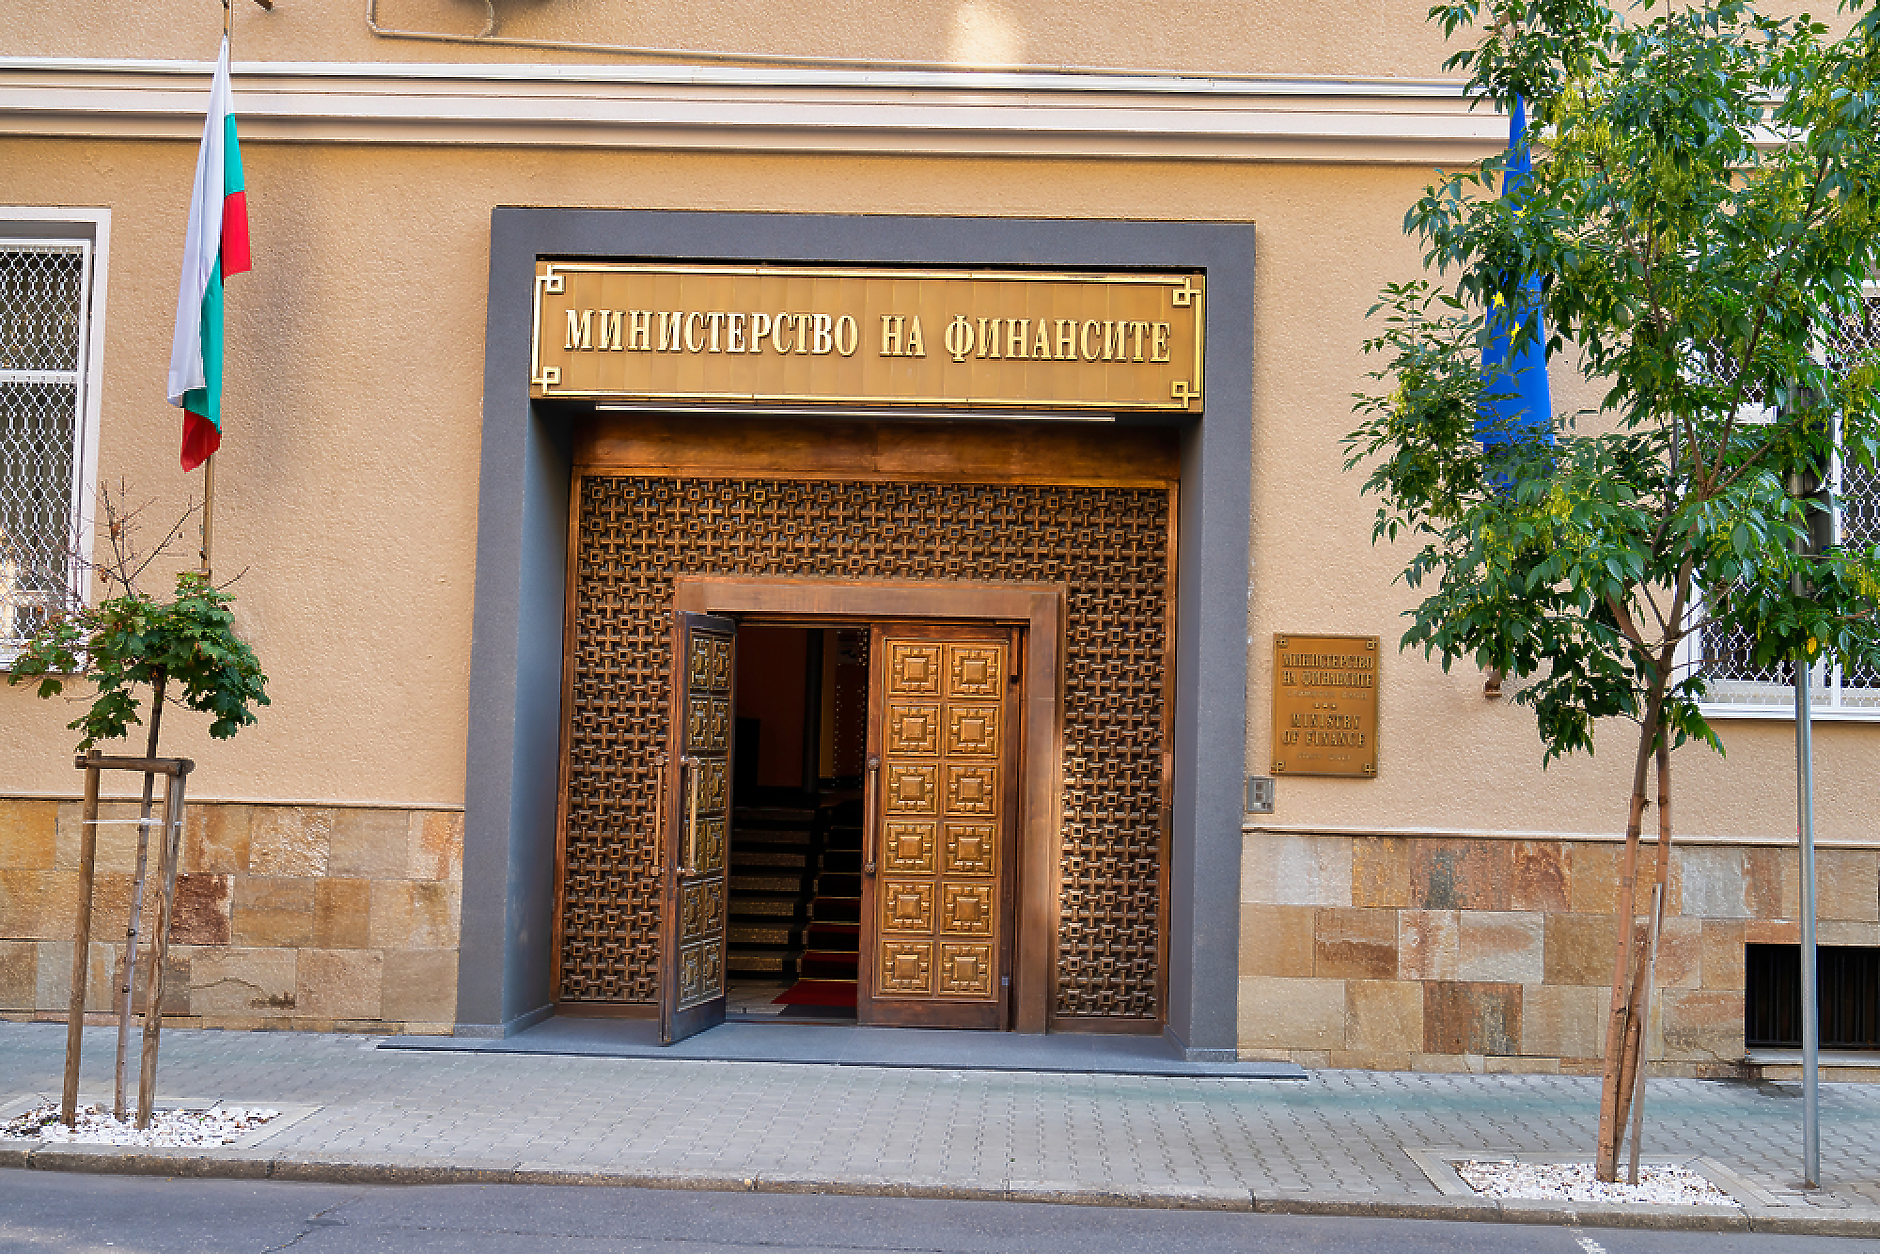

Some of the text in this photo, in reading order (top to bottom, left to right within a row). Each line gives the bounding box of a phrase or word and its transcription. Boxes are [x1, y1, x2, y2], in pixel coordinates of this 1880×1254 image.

[563, 309, 1171, 363] МИНИСТЕРСТВО НА ФИНАНСИТЕ
[1291, 713, 1360, 729] MINISTRY
[1282, 730, 1366, 748] OF FINANCE
